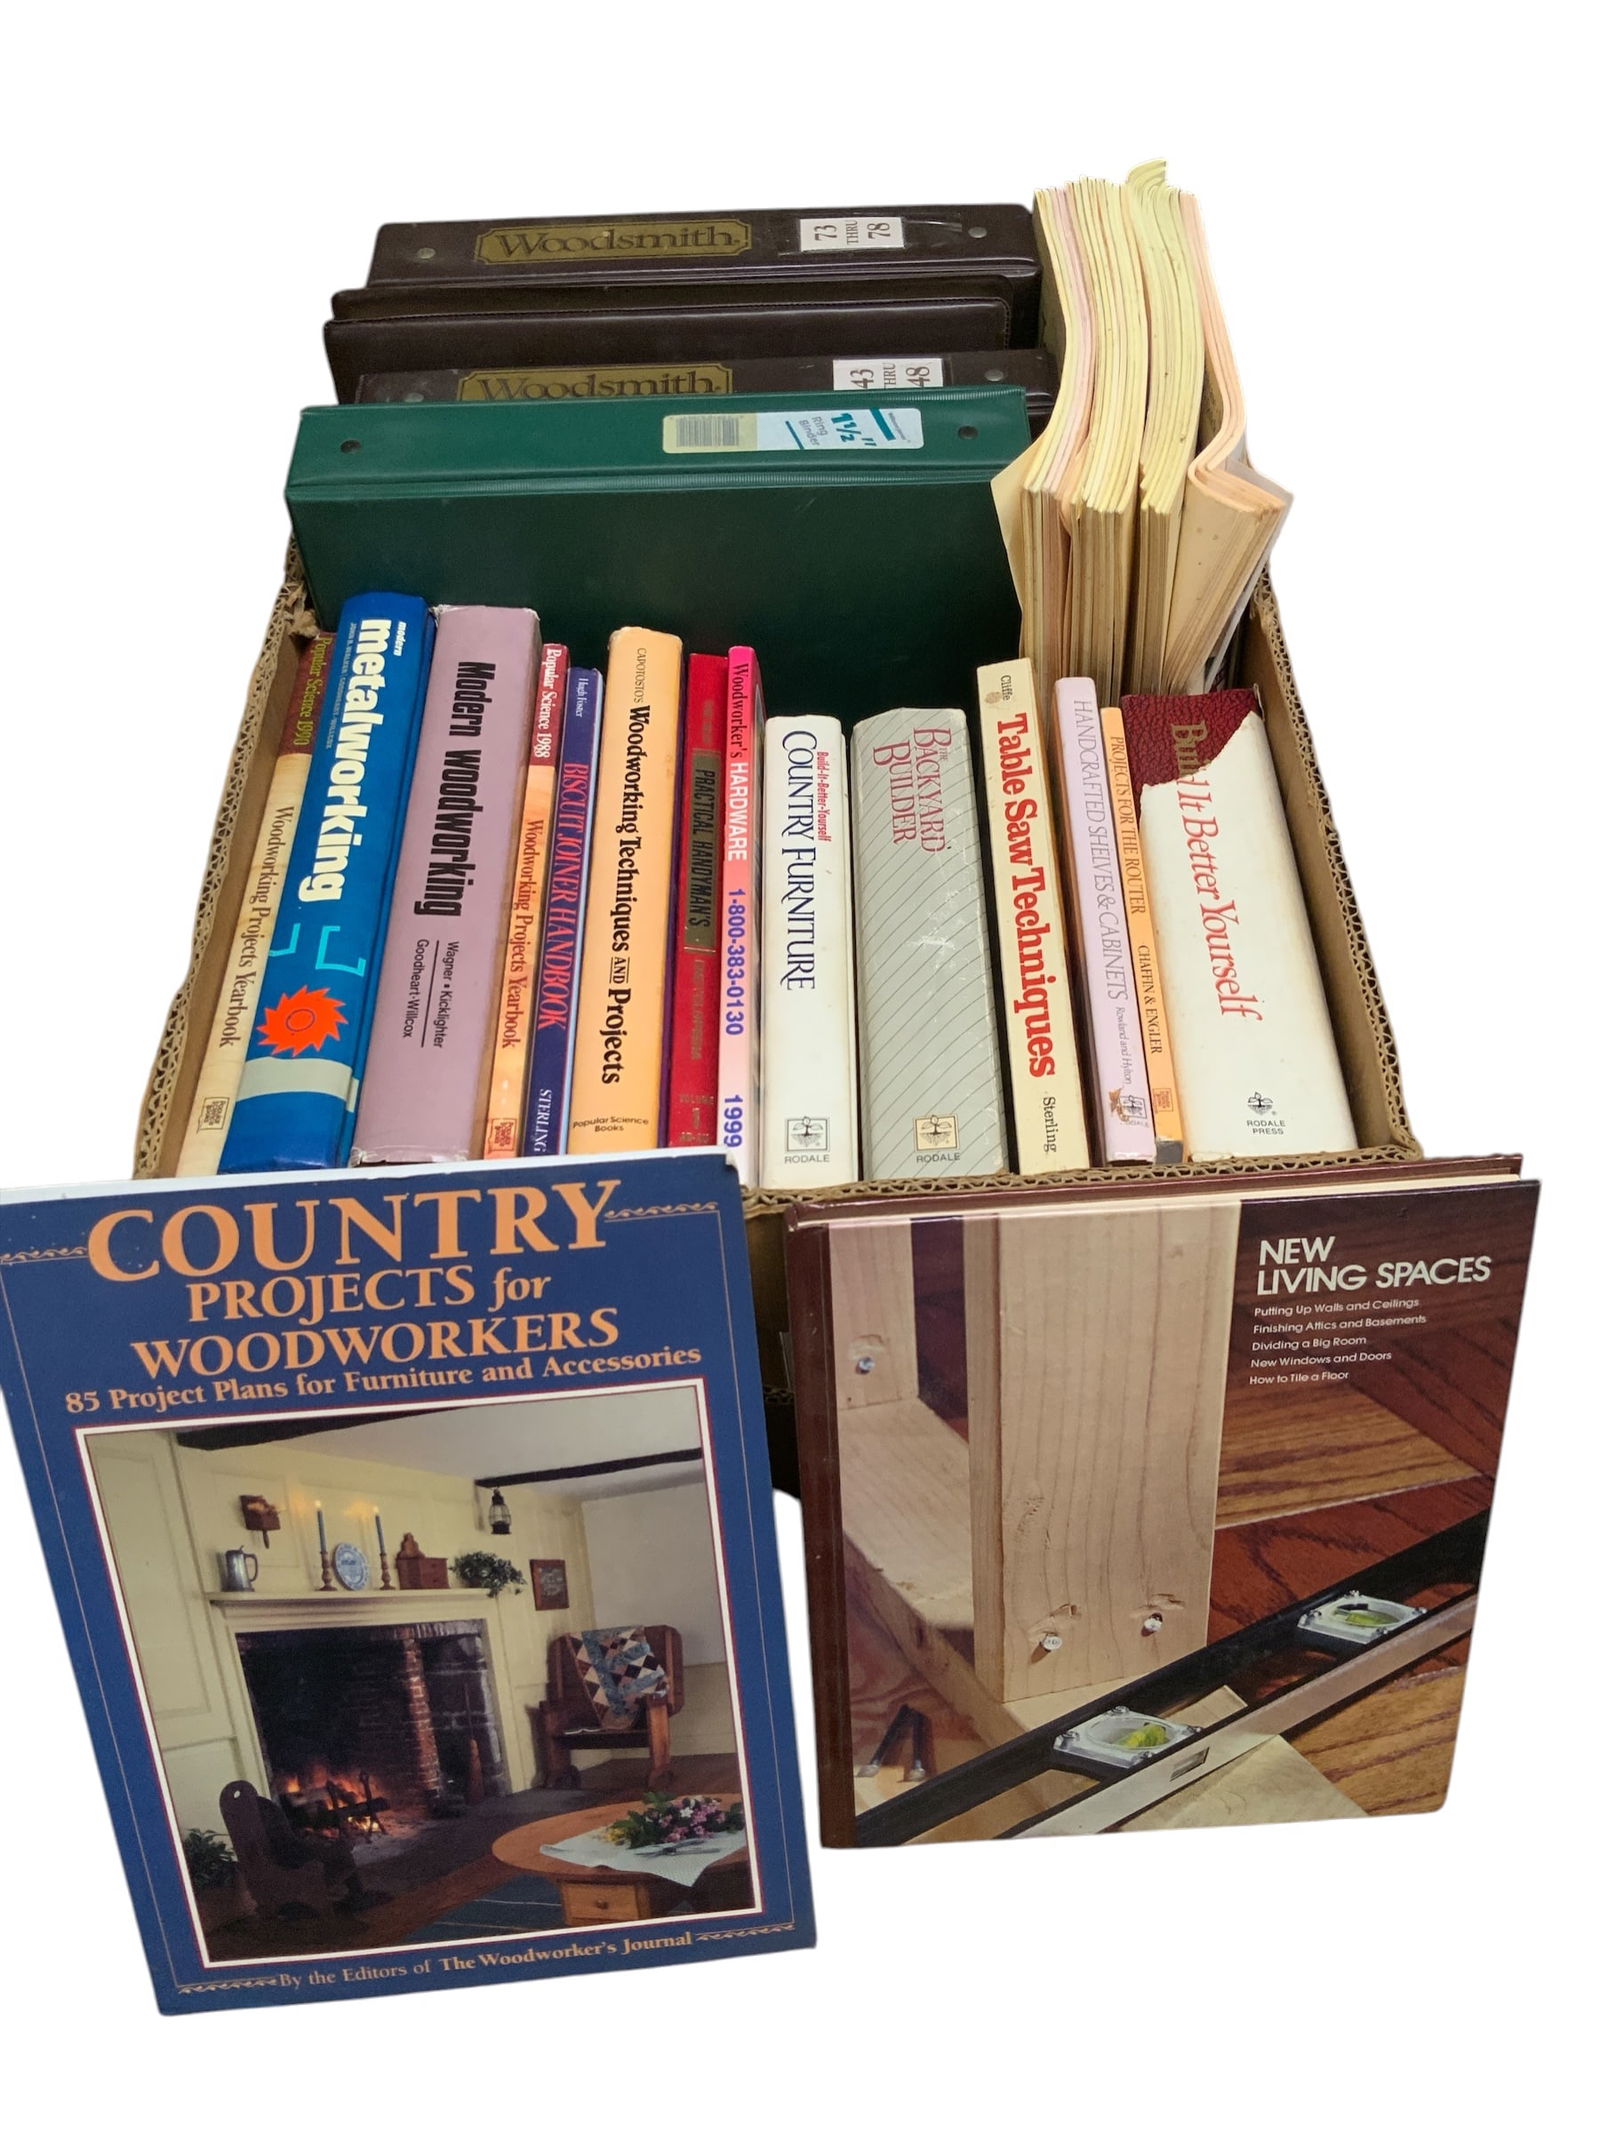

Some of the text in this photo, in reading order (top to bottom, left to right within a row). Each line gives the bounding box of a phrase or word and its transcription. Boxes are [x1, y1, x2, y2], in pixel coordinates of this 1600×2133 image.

[814, 224, 837, 241] 73
[846, 220, 859, 245] THRU
[868, 222, 890, 240] 78
[850, 368, 874, 388] 43
[905, 366, 930, 388] 48
[799, 419, 821, 446] Binder
[812, 416, 829, 436] Ring
[393, 620, 407, 657] modern
[293, 636, 332, 746] Popular Science 1990
[448, 661, 496, 738] Modern
[534, 648, 562, 759] Popular Science 1988
[575, 678, 589, 718] Hugh Foster
[1000, 675, 1013, 701] Cliffe
[298, 618, 392, 902] metalworking
[615, 704, 651, 834] Woodworking
[692, 769, 715, 835] PRACTICAL
[872, 740, 918, 844] BUILDER
[912, 727, 953, 854] BACKYARD
[1176, 790, 1212, 813] It
[1074, 700, 1128, 1000] HANDCRAFTED SHELVES & CABINETS
[1109, 736, 1146, 914] PROJECTS FOR THE ROUTER
[687, 841, 714, 928] HANDYMAN'S
[780, 730, 818, 991] COUNTRY FURNITURE
[1183, 815, 1220, 900] Better
[537, 762, 590, 1030] BISCUIT JOINER HANDBOOK
[610, 836, 643, 952] Techniques
[723, 662, 749, 1148] Woodworker's HARDWARE 1-800-383-0130 1999
[997, 712, 1057, 1078] Table Saw Techniques
[219, 806, 295, 1048] Woodworking Projects Yearbook
[501, 819, 544, 1048] Woodworking Projects Yearbook
[612, 957, 626, 984] AND
[1200, 899, 1263, 1021] Yourself
[432, 941, 460, 1048] Wagner Kicklighter
[1115, 1007, 1127, 1040] Rowland
[1138, 945, 1162, 1054] CHAFFIN & ENGLER
[599, 988, 632, 1085] Projects
[1119, 1040, 1129, 1057] and
[533, 1088, 552, 1152] STERLING
[572, 1116, 649, 1129] Popular Science
[594, 1124, 624, 1133] Books
[1042, 1096, 1057, 1153] Sterling
[1246, 1119, 1286, 1128] RODALE
[1252, 1127, 1284, 1136] PRESS
[784, 1153, 830, 1164] RODALE
[915, 1152, 961, 1164] RODALE
[87, 1179, 622, 1283] COUNTRY
[1258, 1236, 1335, 1266] NEW
[186, 1265, 552, 1325] PROJECTS for
[1257, 1255, 1492, 1296] LIVING SPACES
[1253, 1314, 1427, 1335] Finishing Attics and Basements
[1254, 1298, 1419, 1317] Putting Up Walls and Ceilings
[130, 1307, 620, 1381] WOODWORKERS
[1251, 1351, 1392, 1368] New Windows and Doors
[1252, 1336, 1367, 1352] Dividing a Big Room
[65, 1345, 702, 1413] 85 Project Plans for Furniture and Accessories
[1250, 1375, 1275, 1385] How
[1277, 1374, 1288, 1384] to
[1290, 1373, 1308, 1383] Tile
[1321, 1370, 1349, 1381] Floor
[279, 1931, 691, 1990] By the Editors of The Woodworker's Journal
